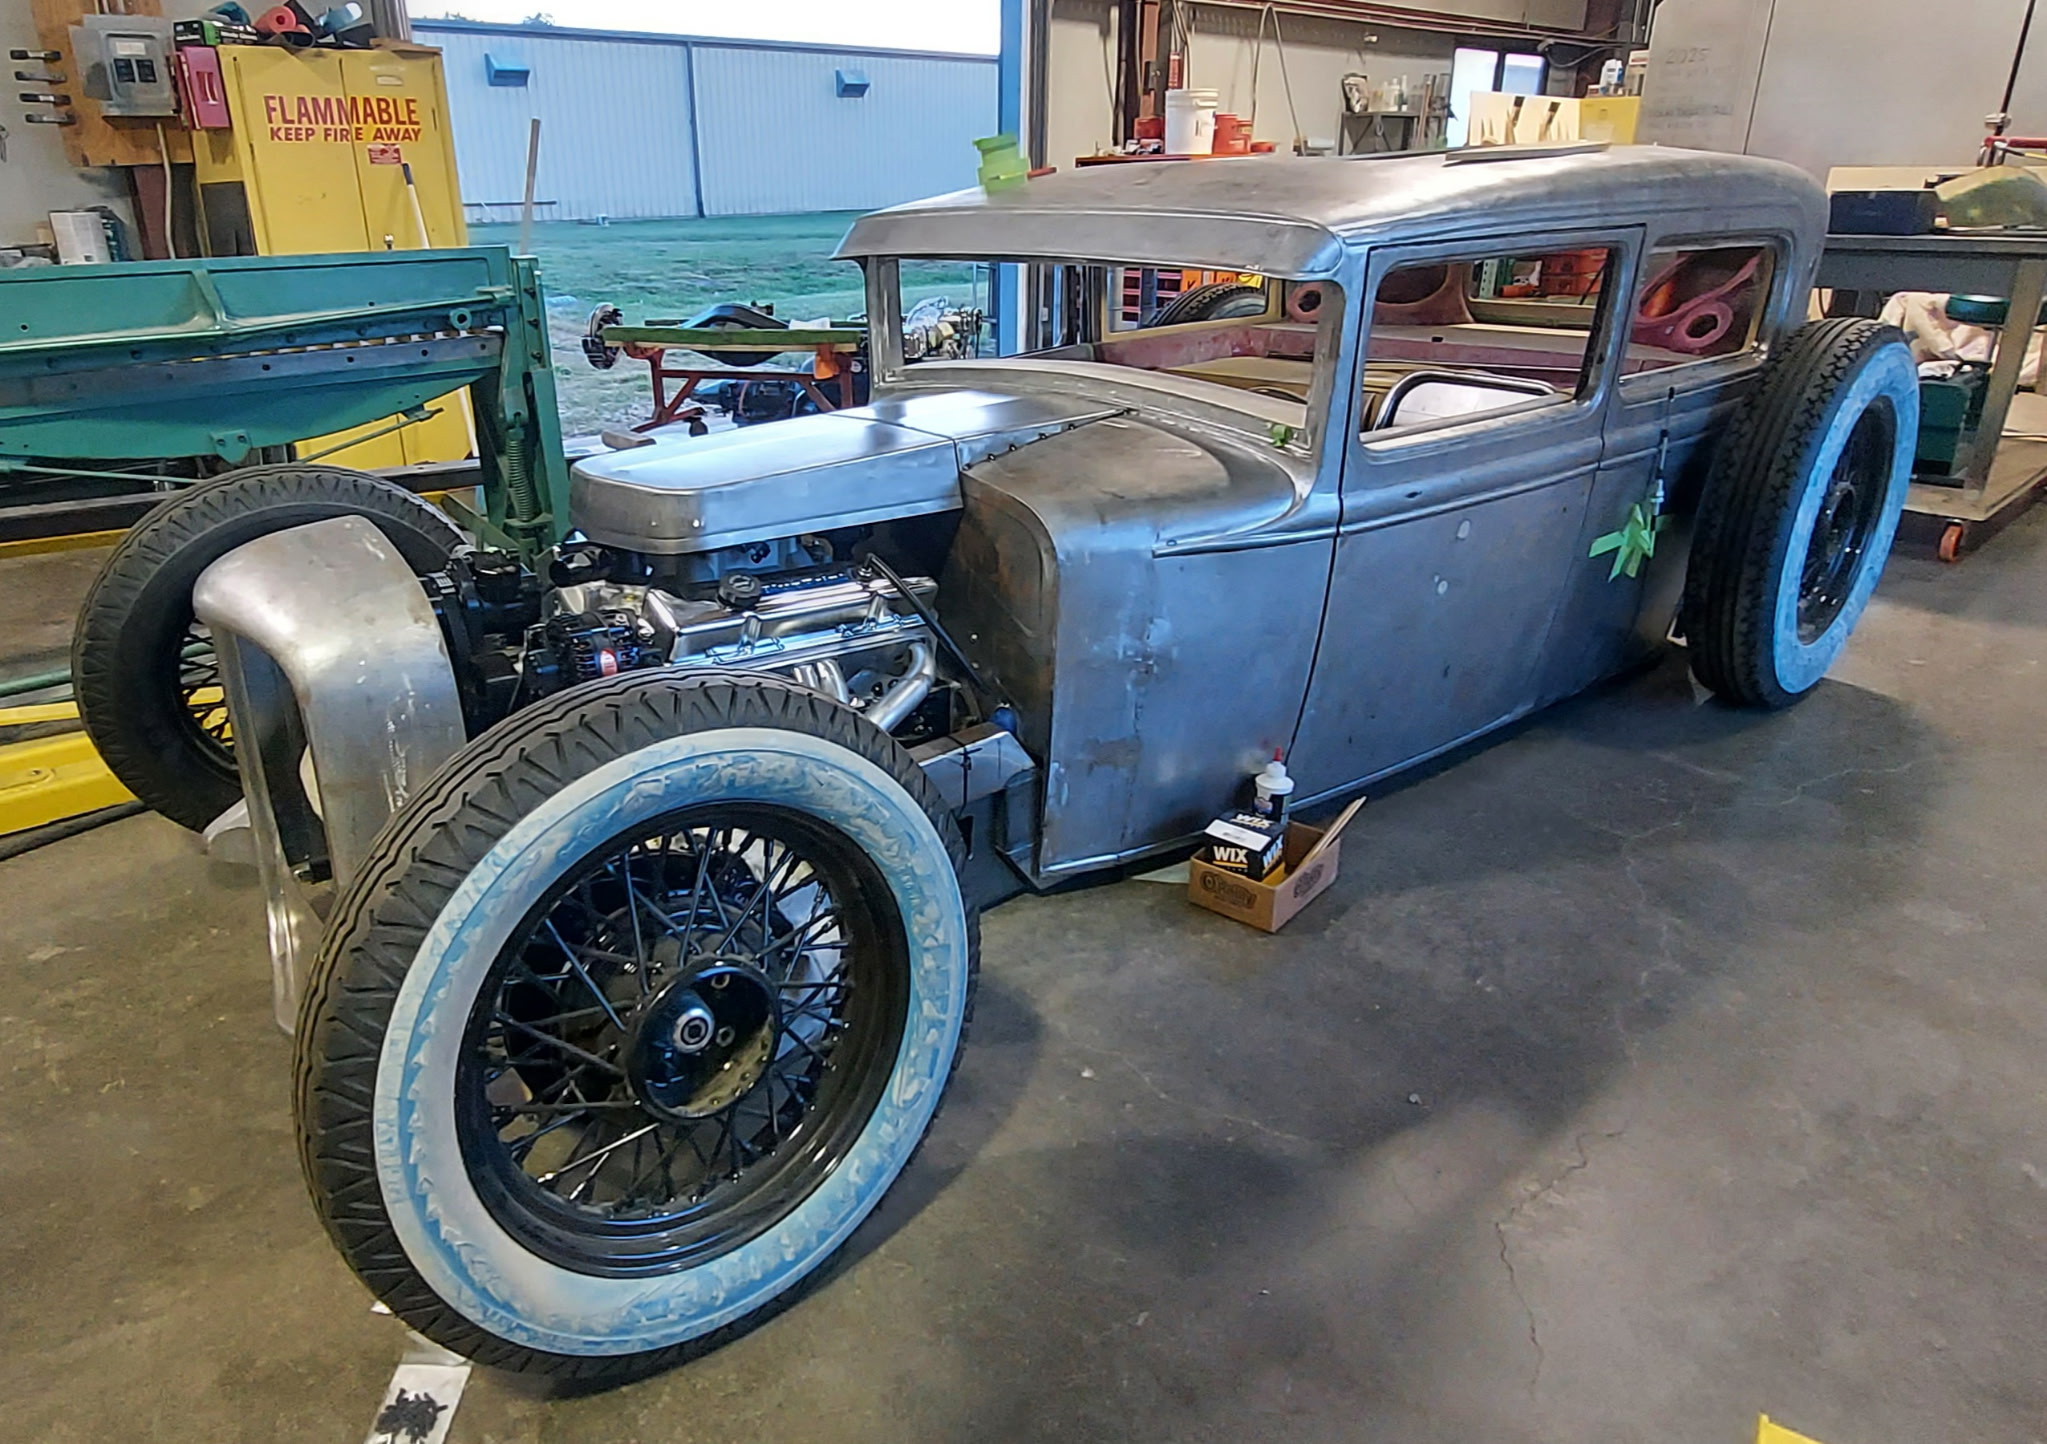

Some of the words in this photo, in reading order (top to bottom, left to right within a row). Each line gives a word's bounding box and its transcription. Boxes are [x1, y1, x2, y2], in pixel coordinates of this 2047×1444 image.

[264, 96, 421, 125] FLAMMABLE
[270, 127, 315, 141] KEEP
[324, 127, 363, 142] FIRE
[373, 127, 421, 142] AWAY
[1213, 846, 1248, 863] WIX
